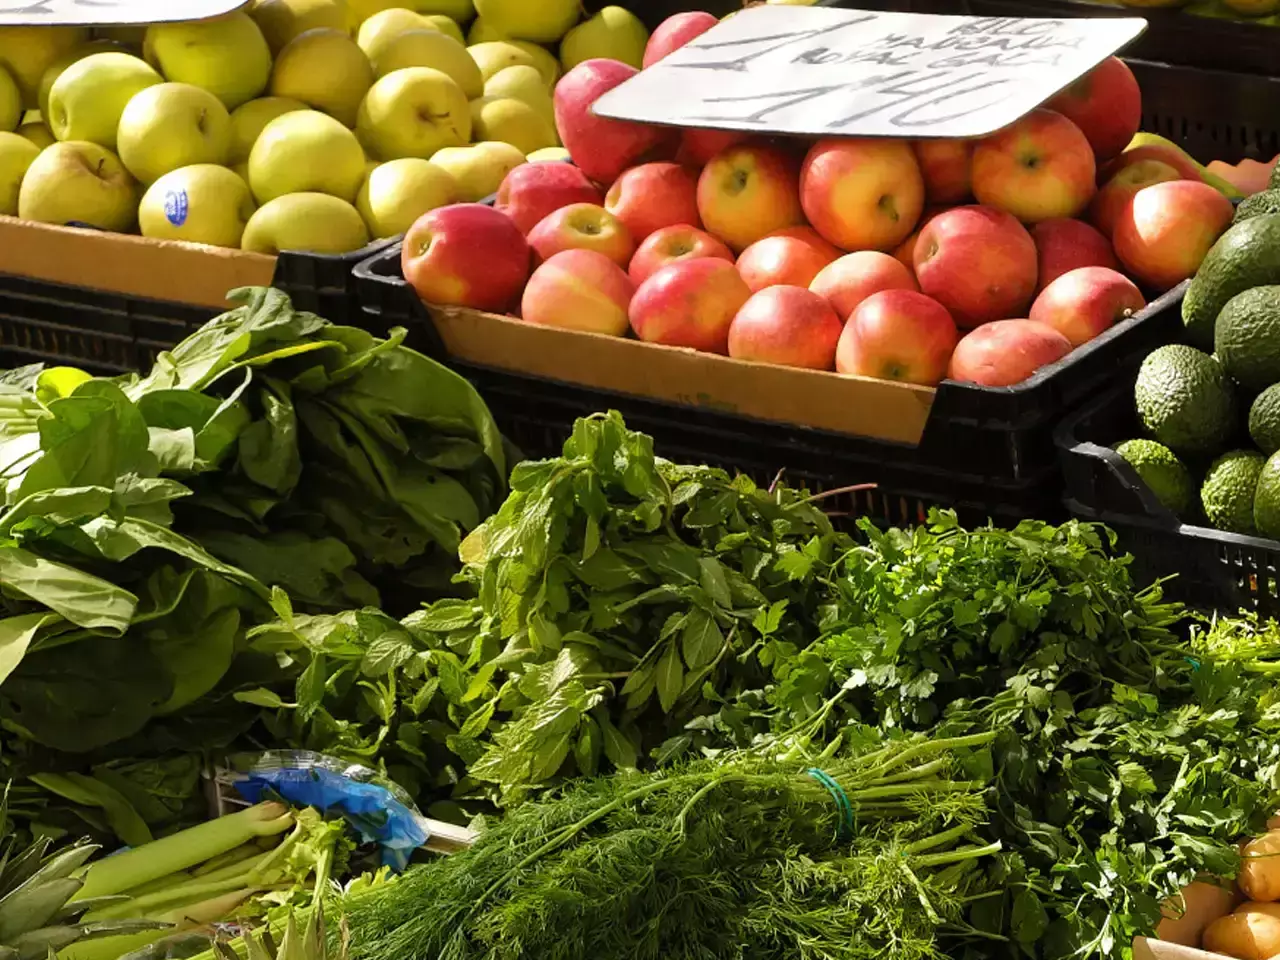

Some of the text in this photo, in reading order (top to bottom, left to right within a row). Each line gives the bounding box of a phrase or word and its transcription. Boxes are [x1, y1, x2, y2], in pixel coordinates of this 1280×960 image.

[668, 14, 1064, 72] 1 KILO
[789, 47, 1062, 68] ROYAL GALA
